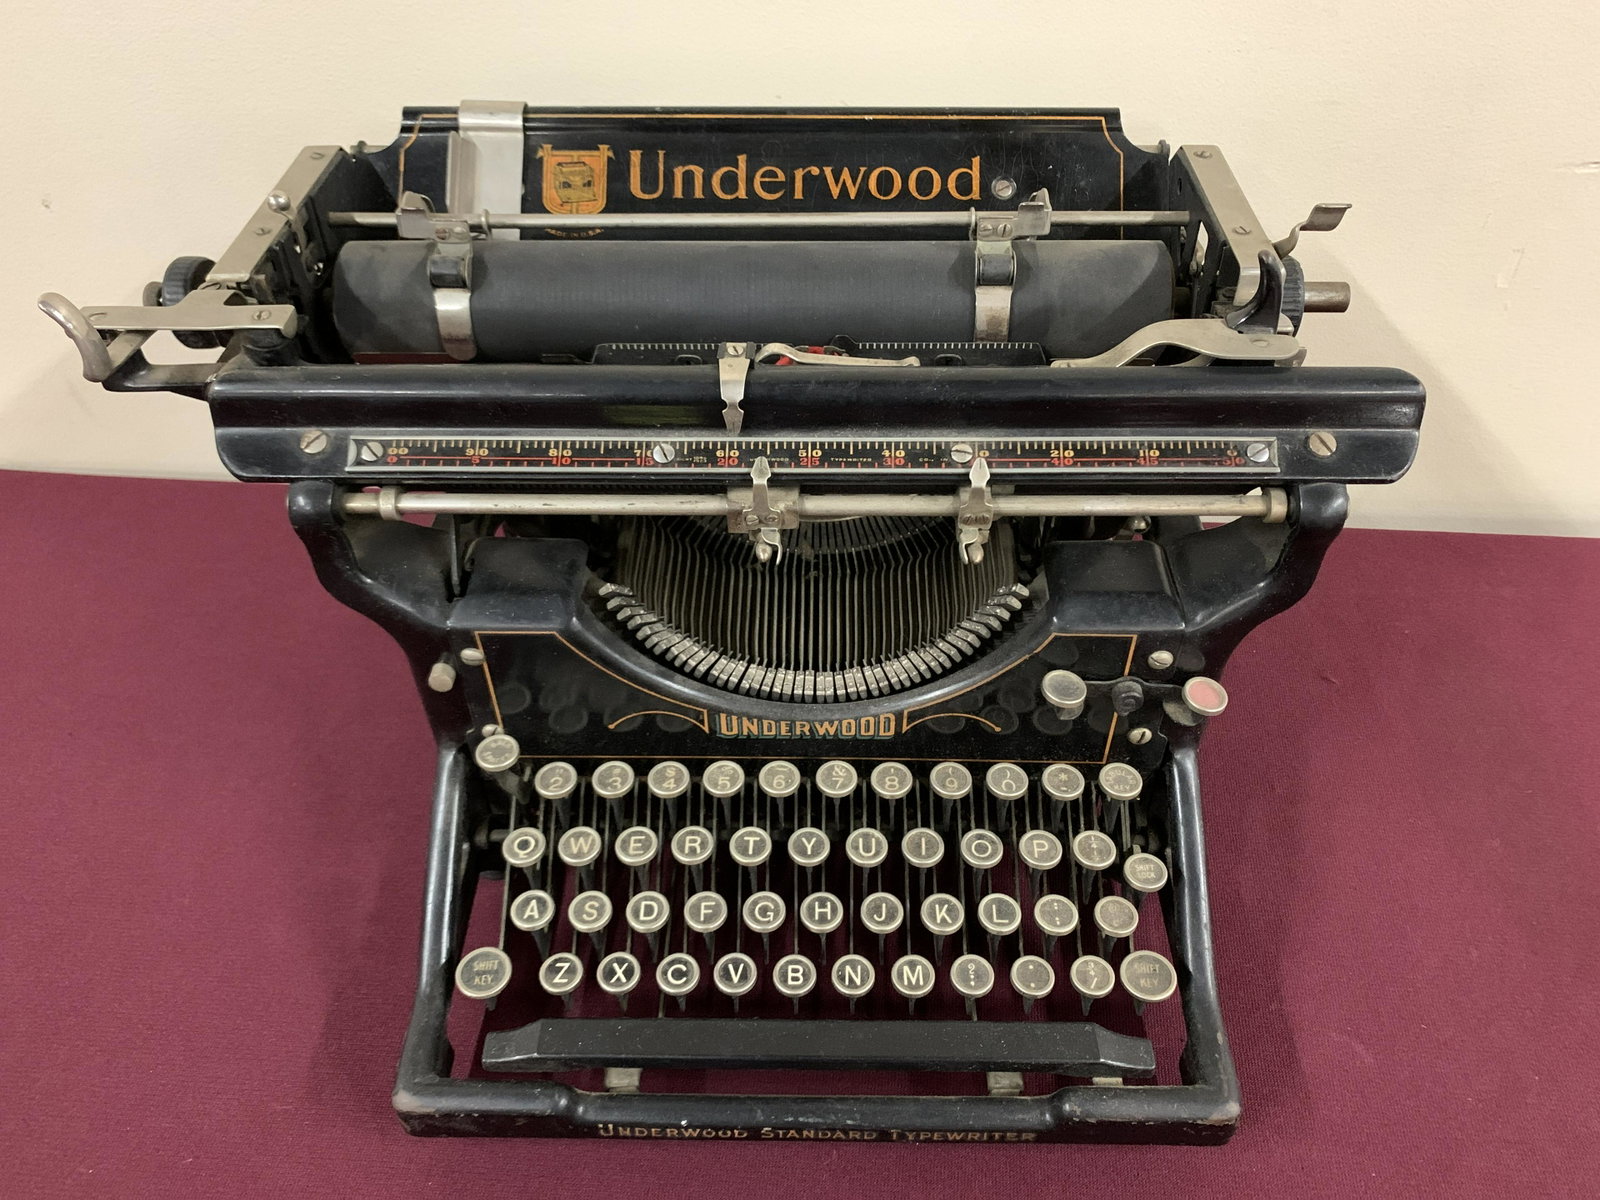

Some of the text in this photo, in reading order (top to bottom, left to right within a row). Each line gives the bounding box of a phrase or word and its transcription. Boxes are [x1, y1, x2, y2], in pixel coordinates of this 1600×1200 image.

[629, 150, 983, 201] Underwood
[465, 448, 489, 456] 90
[548, 449, 572, 457] 80
[716, 450, 740, 458] 60
[798, 450, 822, 458] 50
[882, 449, 906, 458] 40
[1050, 449, 1074, 457] 20
[1140, 449, 1160, 457] 10
[471, 456, 480, 464] 5
[551, 457, 572, 465] 10
[717, 458, 739, 466] 20
[800, 457, 821, 466] 25
[883, 457, 905, 466] 30
[1051, 457, 1073, 466] 40
[1135, 456, 1159, 465] 45
[716, 712, 896, 740] UNDERWOOD
[548, 776, 563, 790] 2
[606, 777, 621, 790] 3
[662, 778, 677, 789] 4
[718, 776, 730, 790] 5
[773, 775, 785, 789] 6
[832, 777, 844, 790] 7
[885, 776, 899, 791] 8
[945, 777, 957, 791] 9
[513, 836, 535, 858] Q
[570, 836, 593, 852] W
[628, 835, 646, 854] E
[684, 836, 701, 854] R
[744, 837, 760, 855] T
[802, 837, 817, 855] Y
[859, 838, 876, 857] U
[921, 838, 926, 856] I
[971, 839, 992, 857] O
[1032, 840, 1049, 858] P
[523, 899, 540, 919] A
[582, 901, 600, 920] S
[639, 901, 659, 920] D
[700, 902, 716, 921] F
[755, 902, 775, 921] G
[814, 902, 831, 920] H
[873, 903, 887, 922] J
[936, 904, 952, 924] K
[992, 903, 1009, 924] L
[473, 960, 498, 971] SHIFT
[552, 962, 571, 983] Z
[609, 962, 629, 983] X
[667, 964, 687, 985] C
[728, 963, 745, 984] V
[1133, 963, 1160, 974] SHIFT
[787, 965, 804, 986] B
[845, 965, 862, 986] N
[903, 965, 924, 986] M
[1140, 977, 1159, 987] KEY
[598, 1123, 1037, 1142] UNDERWOOD STANDARD TYPEWRITER
